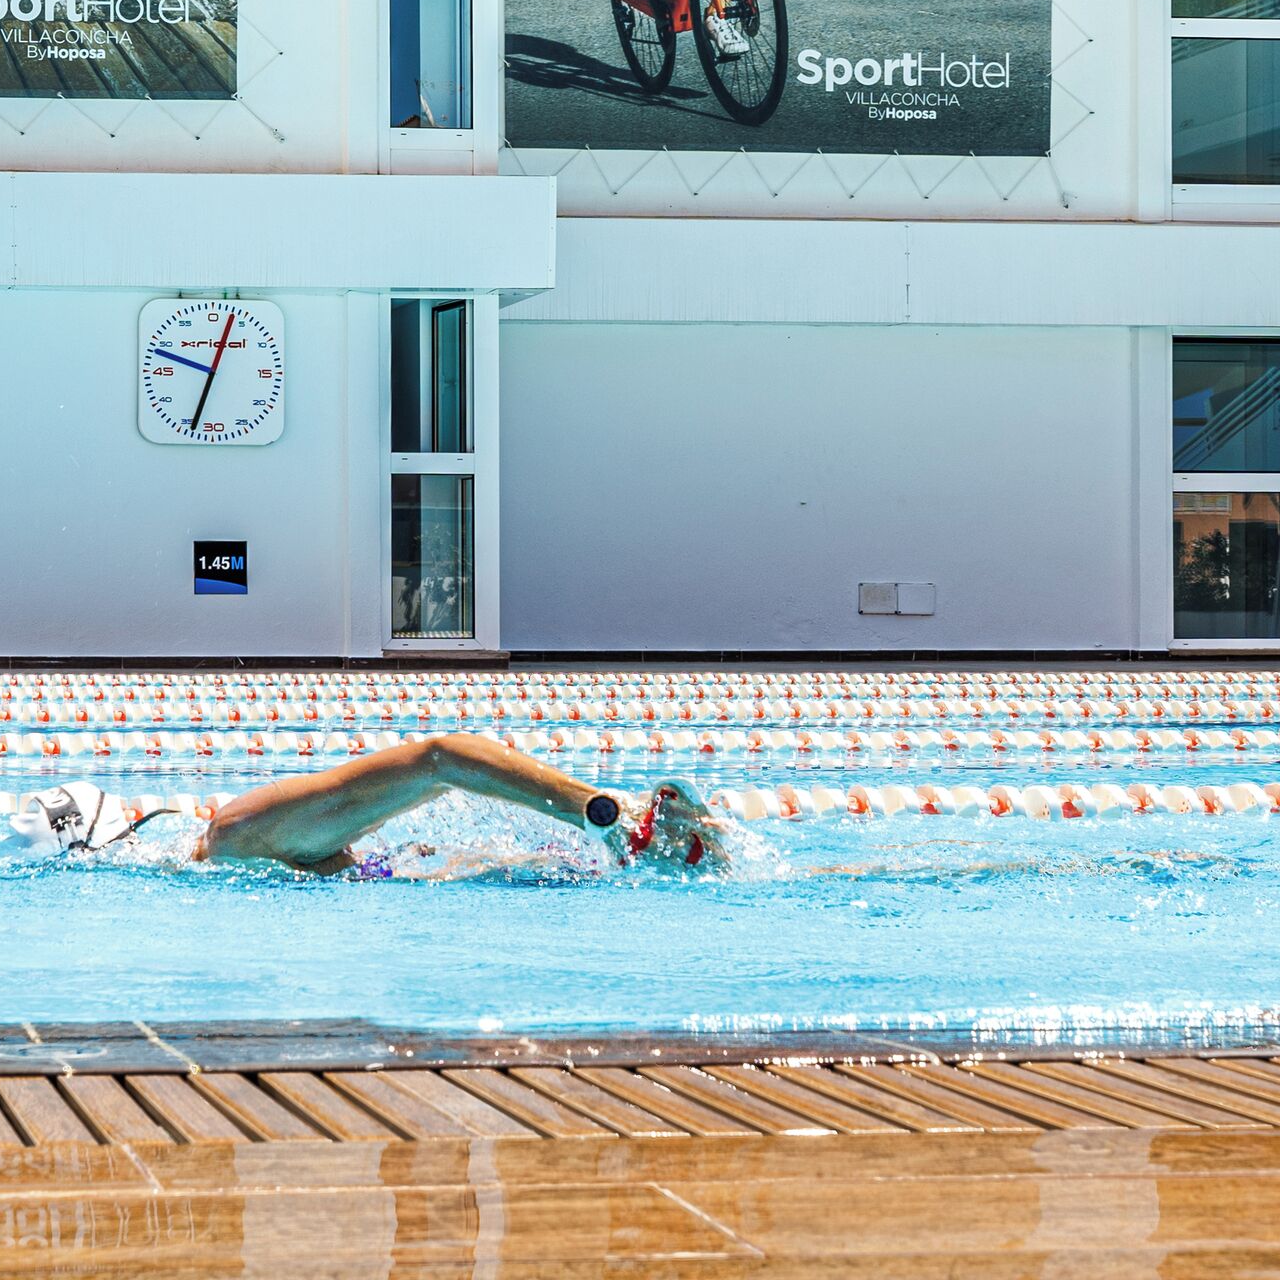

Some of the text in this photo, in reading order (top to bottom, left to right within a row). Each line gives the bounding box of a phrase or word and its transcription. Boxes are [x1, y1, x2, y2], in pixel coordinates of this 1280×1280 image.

[0, 28, 133, 45] VILLACONCHA
[26, 45, 106, 61] ByHoposa
[796, 48, 1010, 92] SportHotel
[845, 91, 961, 107] VILLACONCHA
[868, 107, 937, 121] ByHoposa
[207, 312, 219, 322] 0
[152, 367, 174, 376] 45
[257, 369, 272, 378] 15
[203, 423, 225, 432] 30
[198, 555, 244, 570] 1.45M
